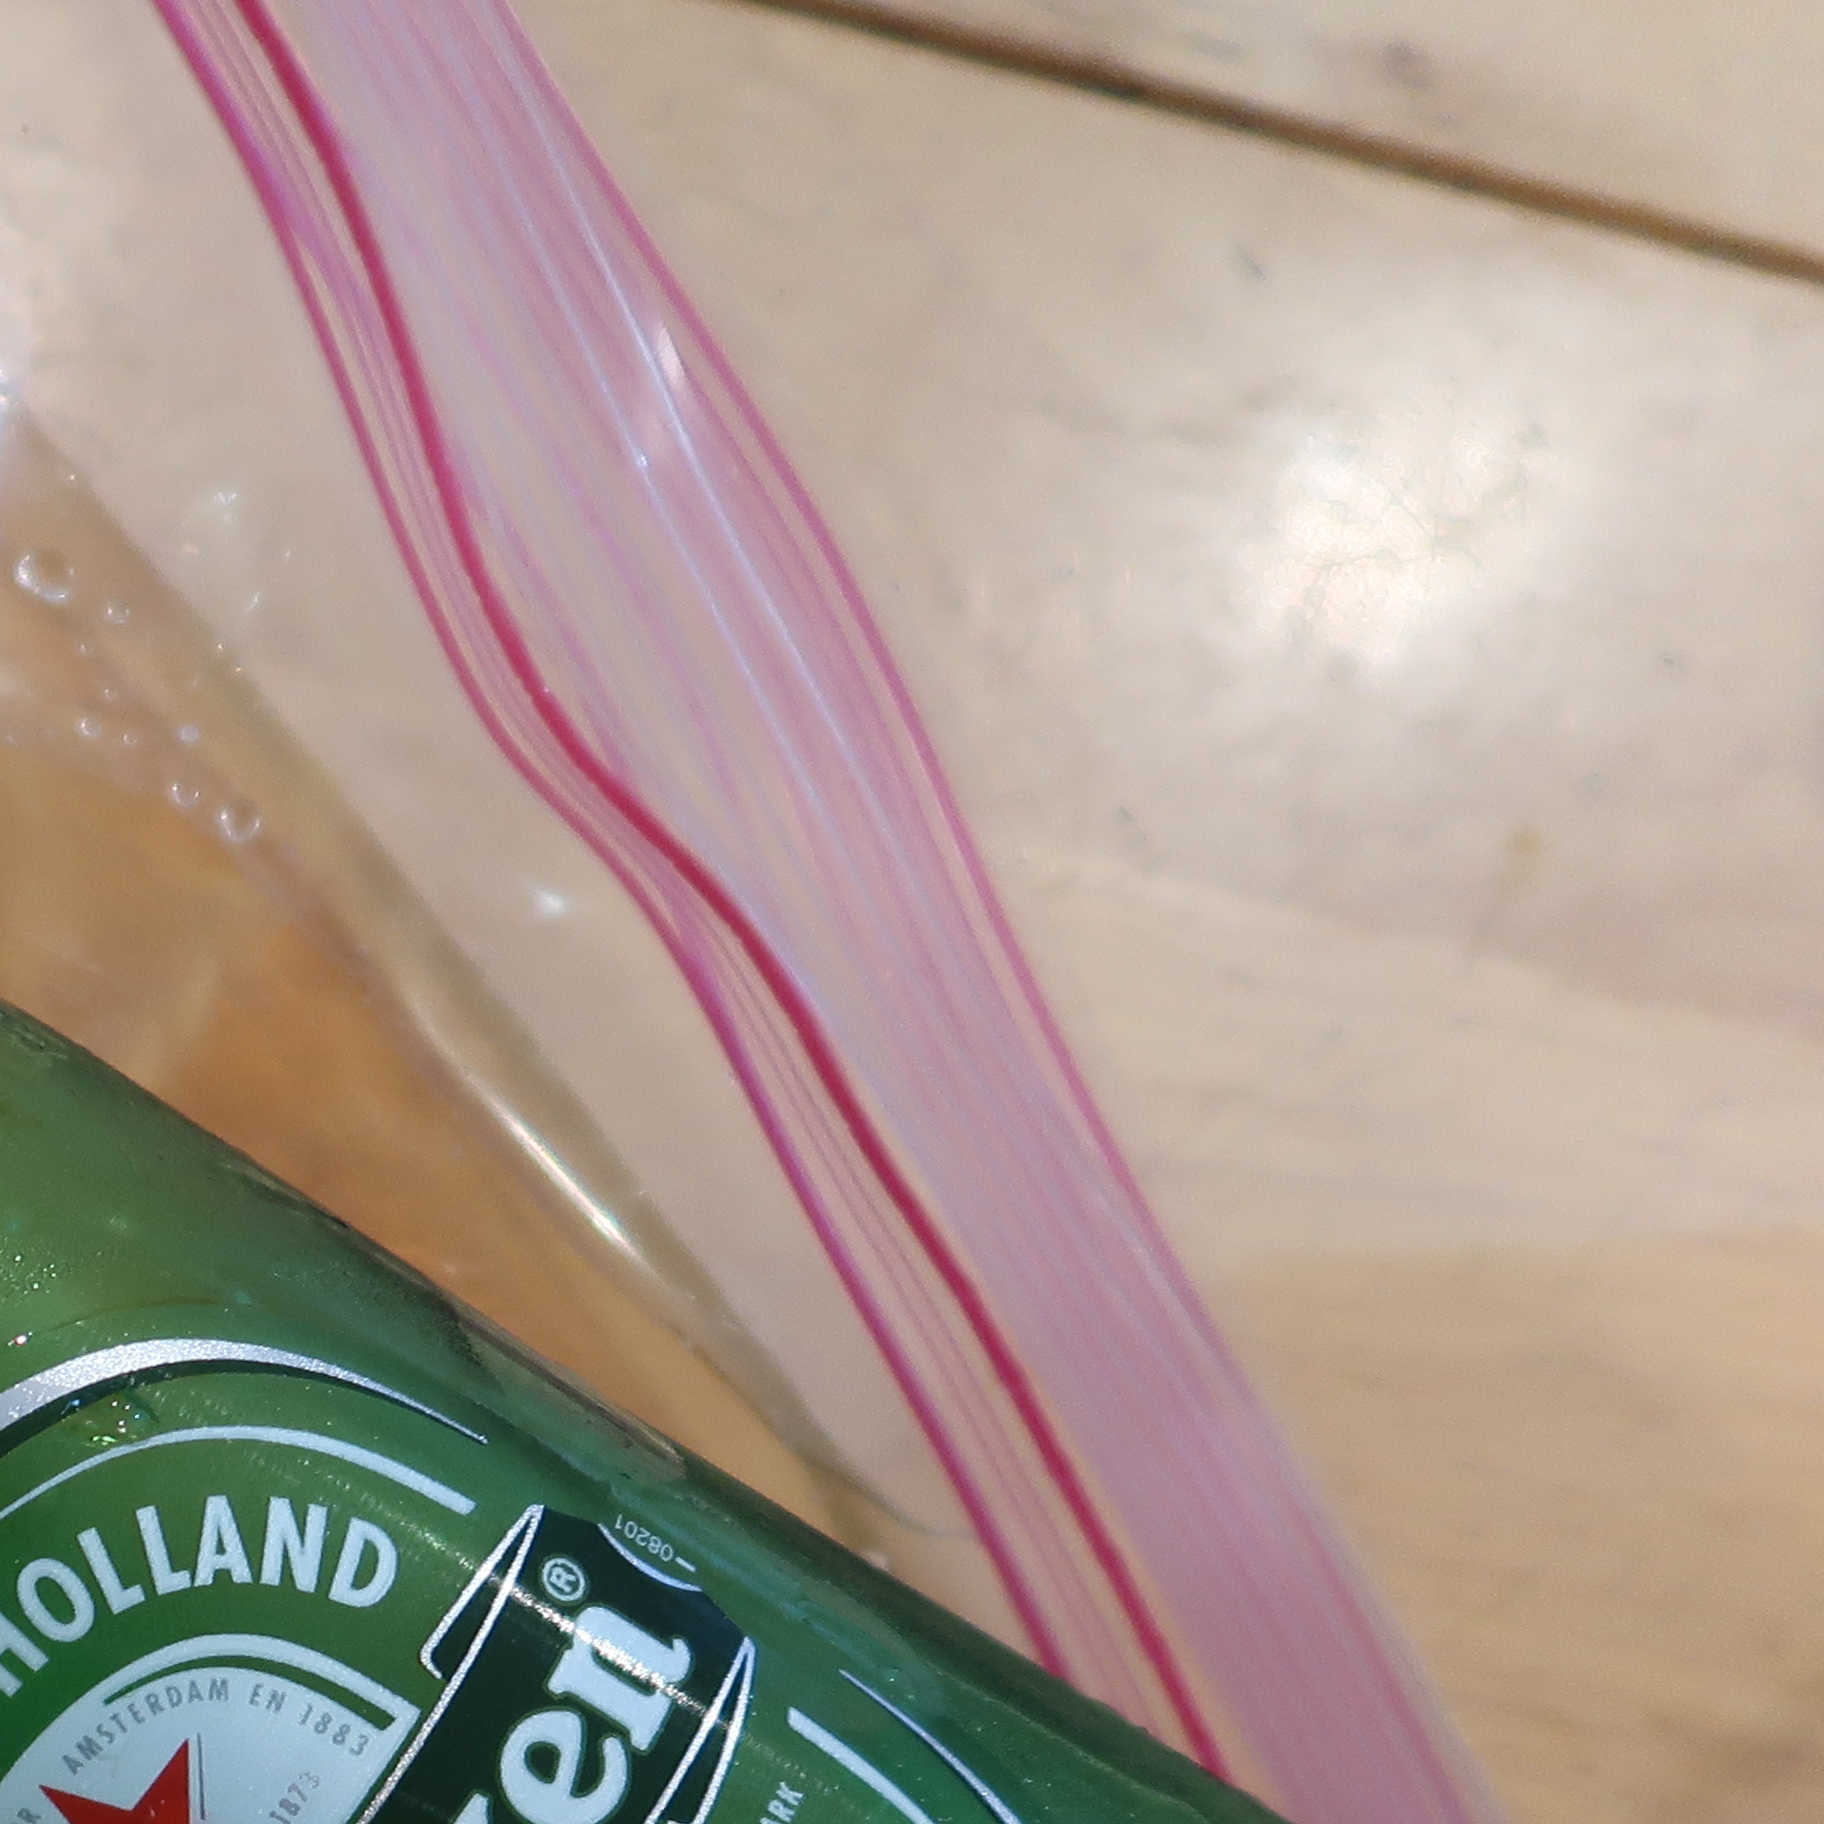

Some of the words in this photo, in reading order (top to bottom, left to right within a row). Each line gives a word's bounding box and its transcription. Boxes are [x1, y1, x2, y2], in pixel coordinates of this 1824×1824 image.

[62, 1678, 230, 1776] AMSTERDAM
[249, 1682, 287, 1715] EN
[298, 1703, 370, 1757] 1883
